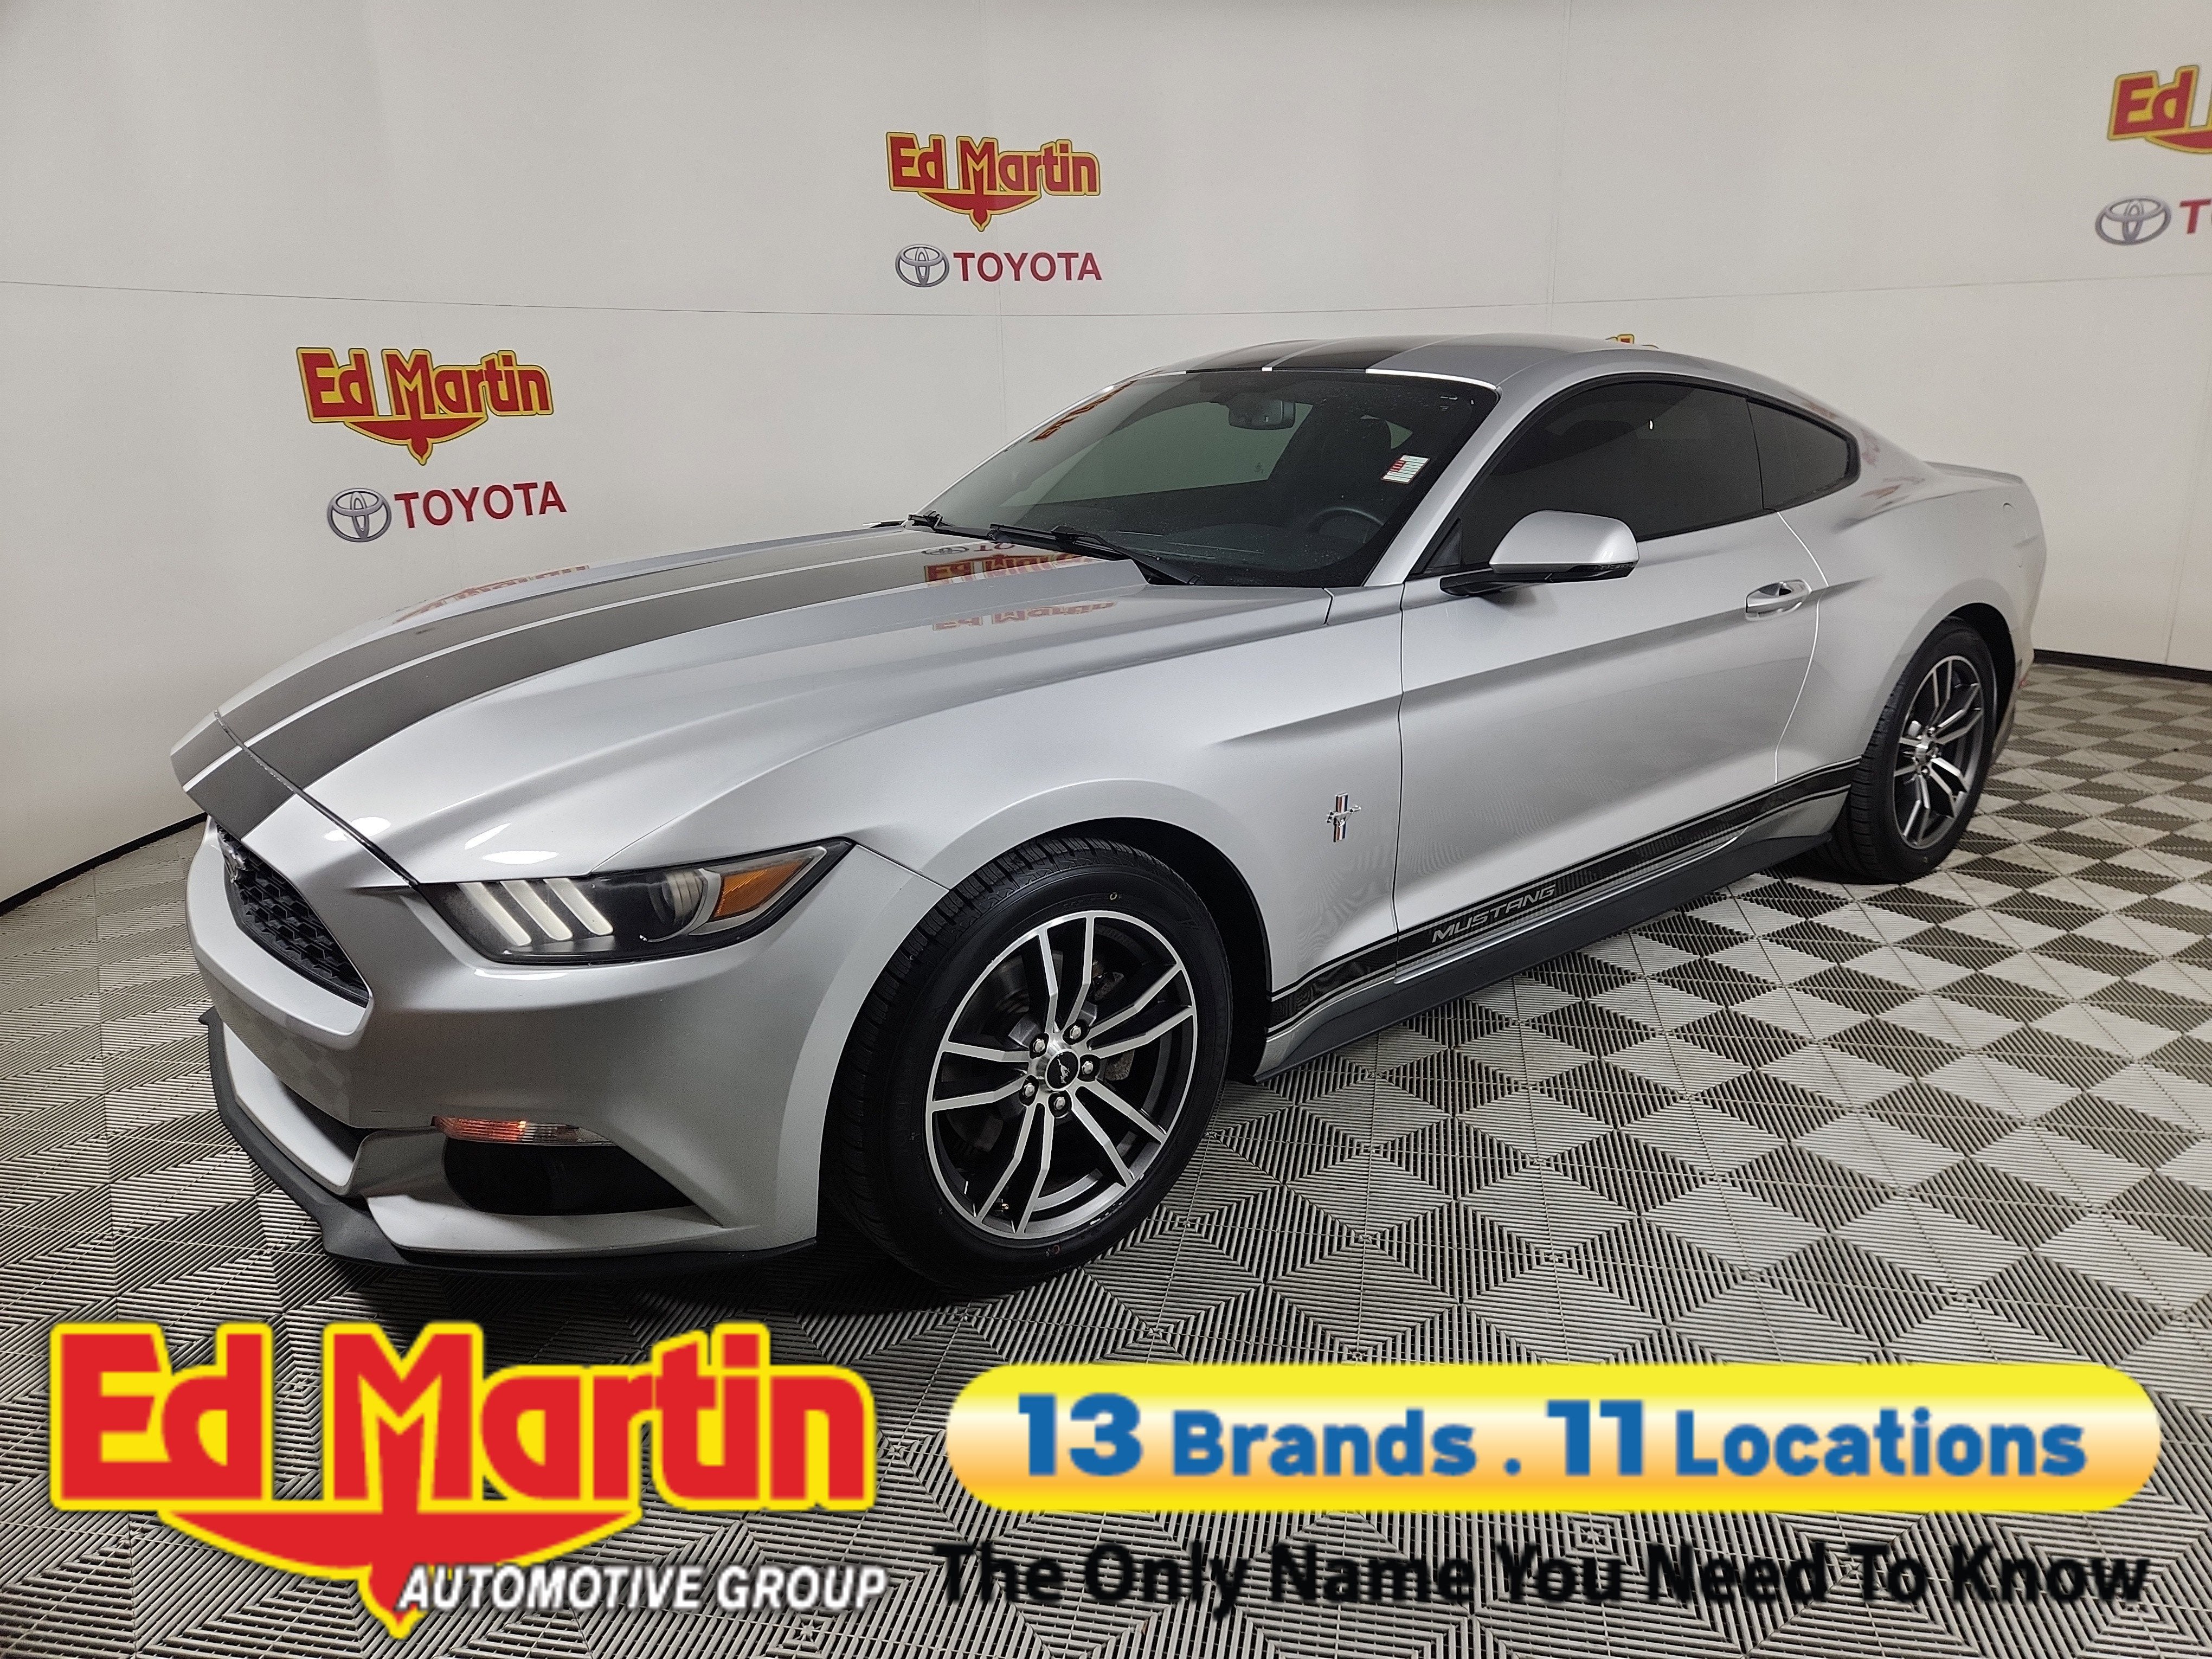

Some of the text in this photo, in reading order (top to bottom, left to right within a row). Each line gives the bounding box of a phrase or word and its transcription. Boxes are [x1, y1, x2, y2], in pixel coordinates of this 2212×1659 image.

[2112, 68, 2196, 136] Ed
[889, 136, 1098, 193] Ed Martin
[2179, 197, 2212, 235] T
[953, 252, 1103, 282] TOYOTA
[300, 352, 550, 419] Ed Martin
[394, 481, 567, 529] TOYOTA
[1431, 884, 1556, 943] MUSTANG
